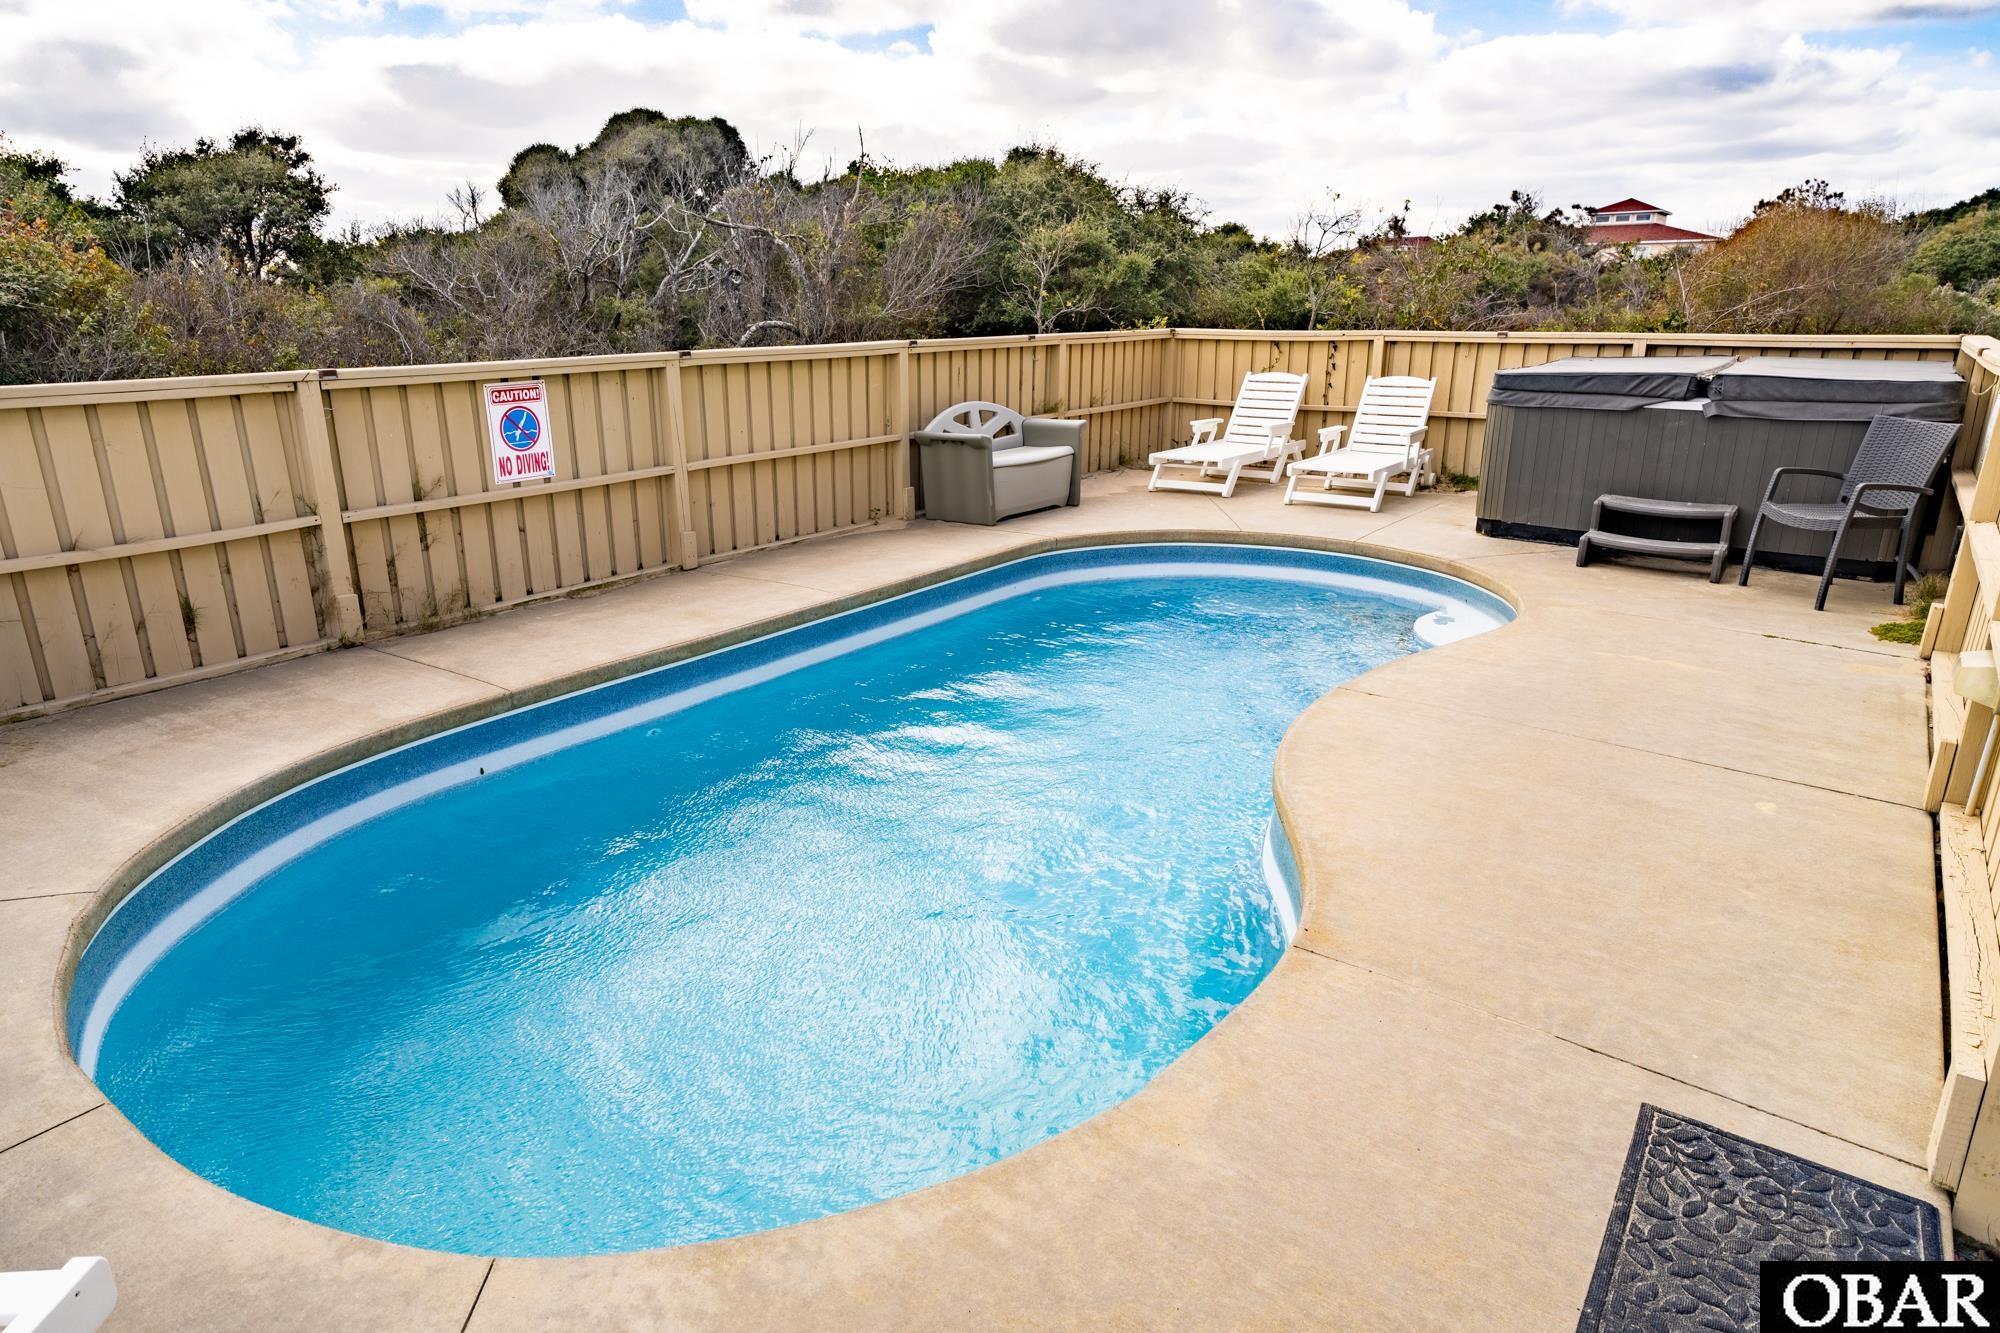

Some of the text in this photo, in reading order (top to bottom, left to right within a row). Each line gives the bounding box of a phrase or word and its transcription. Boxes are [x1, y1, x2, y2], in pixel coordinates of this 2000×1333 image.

[492, 388, 540, 402] CAUTION!
[498, 450, 550, 477] NO DIVING!
